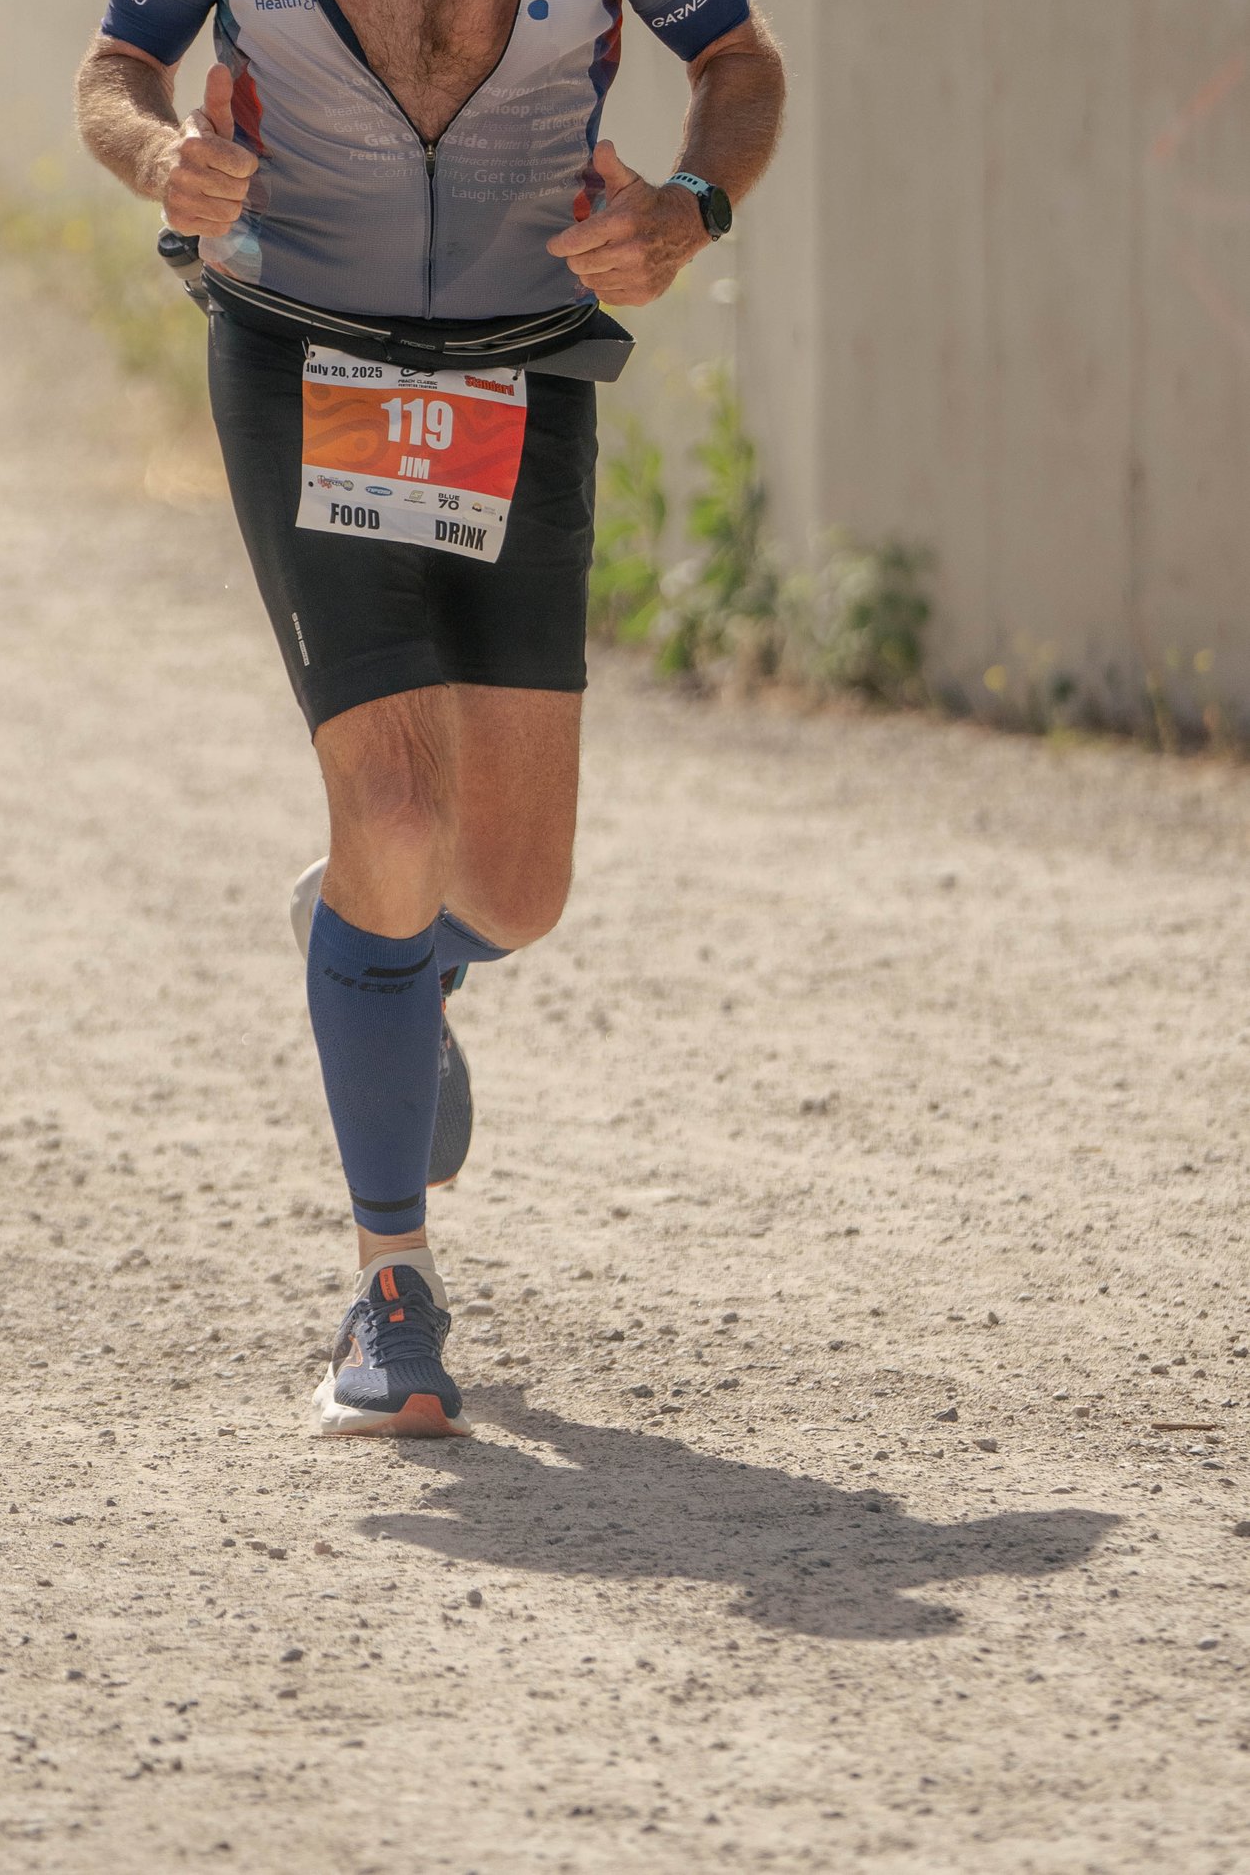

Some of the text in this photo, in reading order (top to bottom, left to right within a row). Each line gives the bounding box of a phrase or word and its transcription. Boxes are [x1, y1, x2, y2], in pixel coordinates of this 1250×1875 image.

[363, 132, 400, 147] Get
[381, 150, 405, 161] the
[440, 152, 489, 166] Embrace
[490, 156, 508, 167] the
[474, 169, 504, 183] Get
[510, 171, 526, 184] to
[451, 185, 499, 203] Laugh,
[305, 361, 383, 380] July 20, 2025
[464, 375, 515, 396] Standard
[381, 397, 454, 450] 119
[398, 455, 431, 480] JIM
[438, 492, 460, 501] BLUE
[438, 498, 460, 510] 70
[330, 502, 381, 530] FOOD
[435, 519, 487, 551] DRINK
